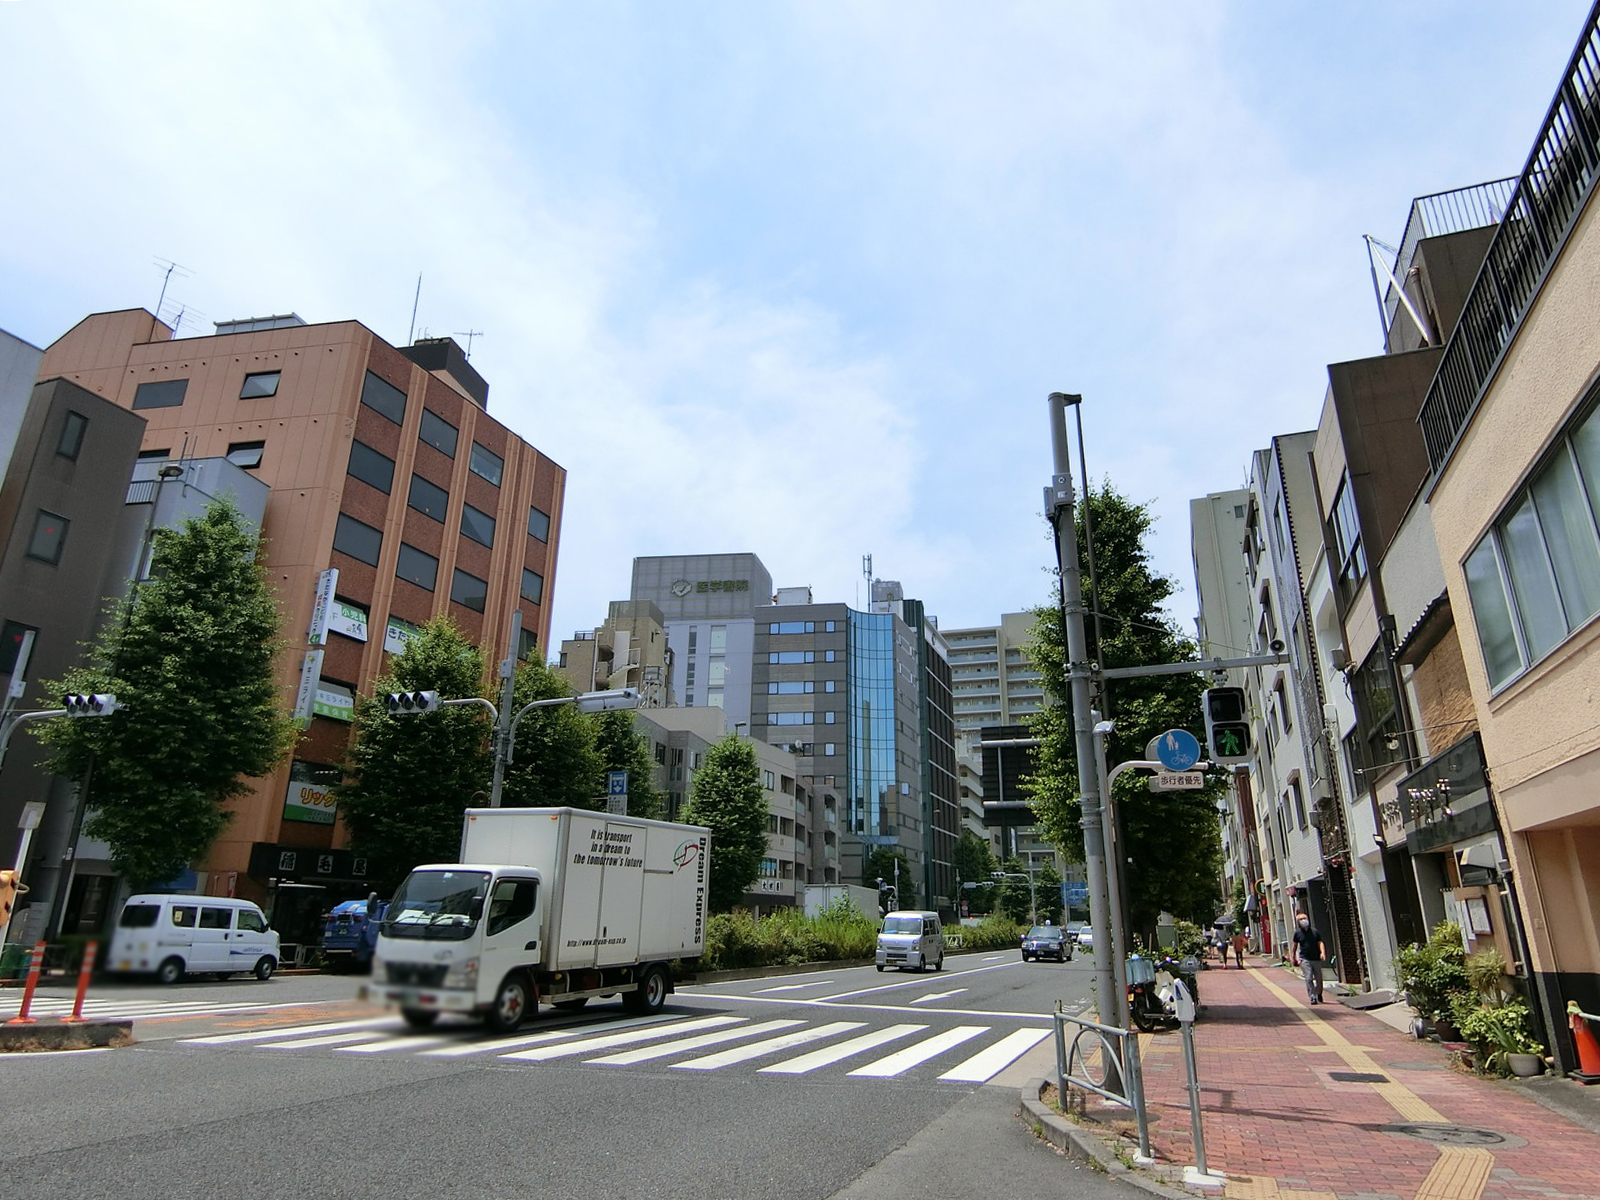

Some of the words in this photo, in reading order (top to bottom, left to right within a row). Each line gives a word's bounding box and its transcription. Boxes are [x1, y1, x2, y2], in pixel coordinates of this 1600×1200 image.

[696, 579, 749, 593] 医学書院
[342, 608, 366, 624] 小児科
[1161, 775, 1202, 786] 歩行者優先
[590, 829, 597, 839] It
[597, 829, 604, 840] is
[604, 830, 633, 843] transport
[591, 842, 597, 852] in
[598, 845, 603, 853] a
[604, 843, 623, 854] dream
[624, 846, 631, 855] to
[573, 854, 586, 865] the
[587, 854, 624, 867] tomorrow's
[625, 855, 643, 868] future
[698, 837, 706, 883] Dream
[694, 887, 704, 944] Express
